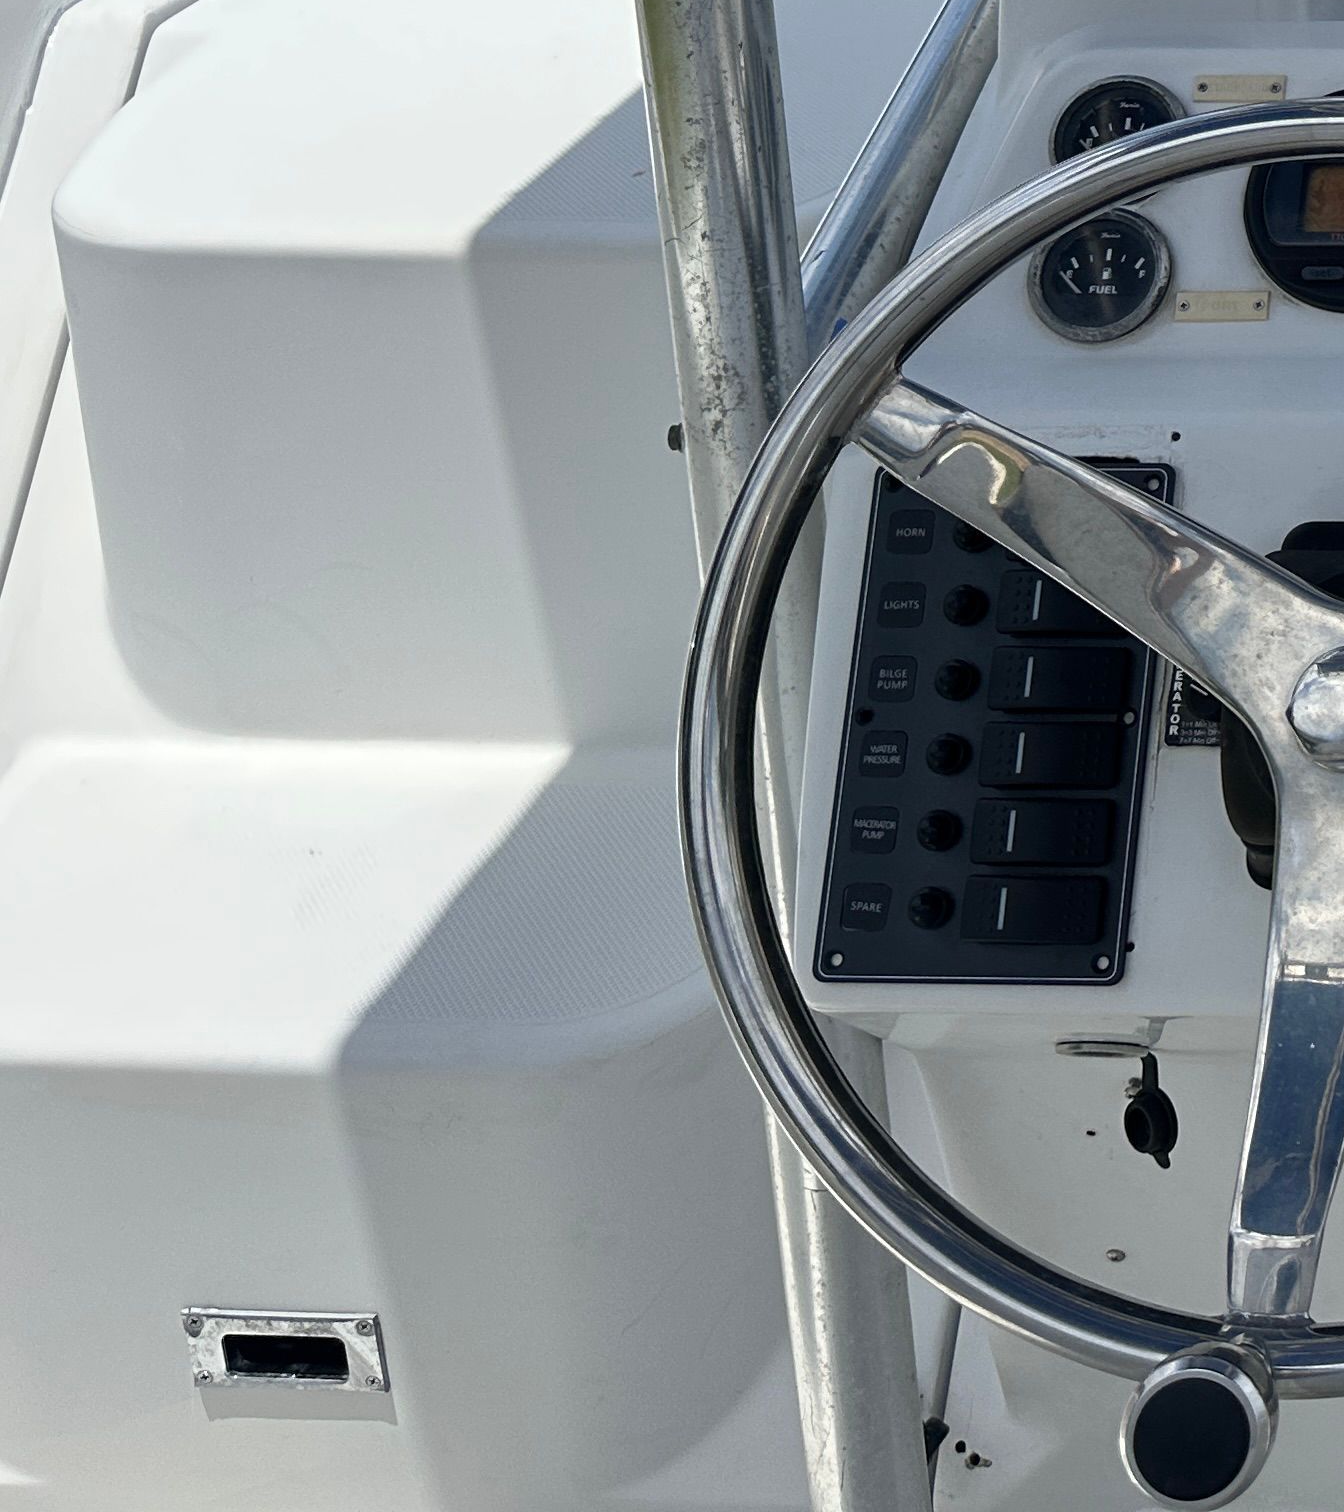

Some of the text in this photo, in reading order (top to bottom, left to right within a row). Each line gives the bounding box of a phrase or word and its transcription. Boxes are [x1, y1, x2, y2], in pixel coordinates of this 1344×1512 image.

[1088, 285, 1118, 295] FUEL
[895, 527, 926, 537] HORN
[884, 600, 920, 610] LIGHTS
[879, 668, 909, 679] BILGE
[877, 679, 908, 689] PUMP
[1169, 669, 1184, 736] ERATOR
[870, 744, 898, 754] WATER
[864, 755, 902, 765] PRESSURE
[862, 830, 885, 839] PUMP
[851, 901, 883, 912] SPARE
